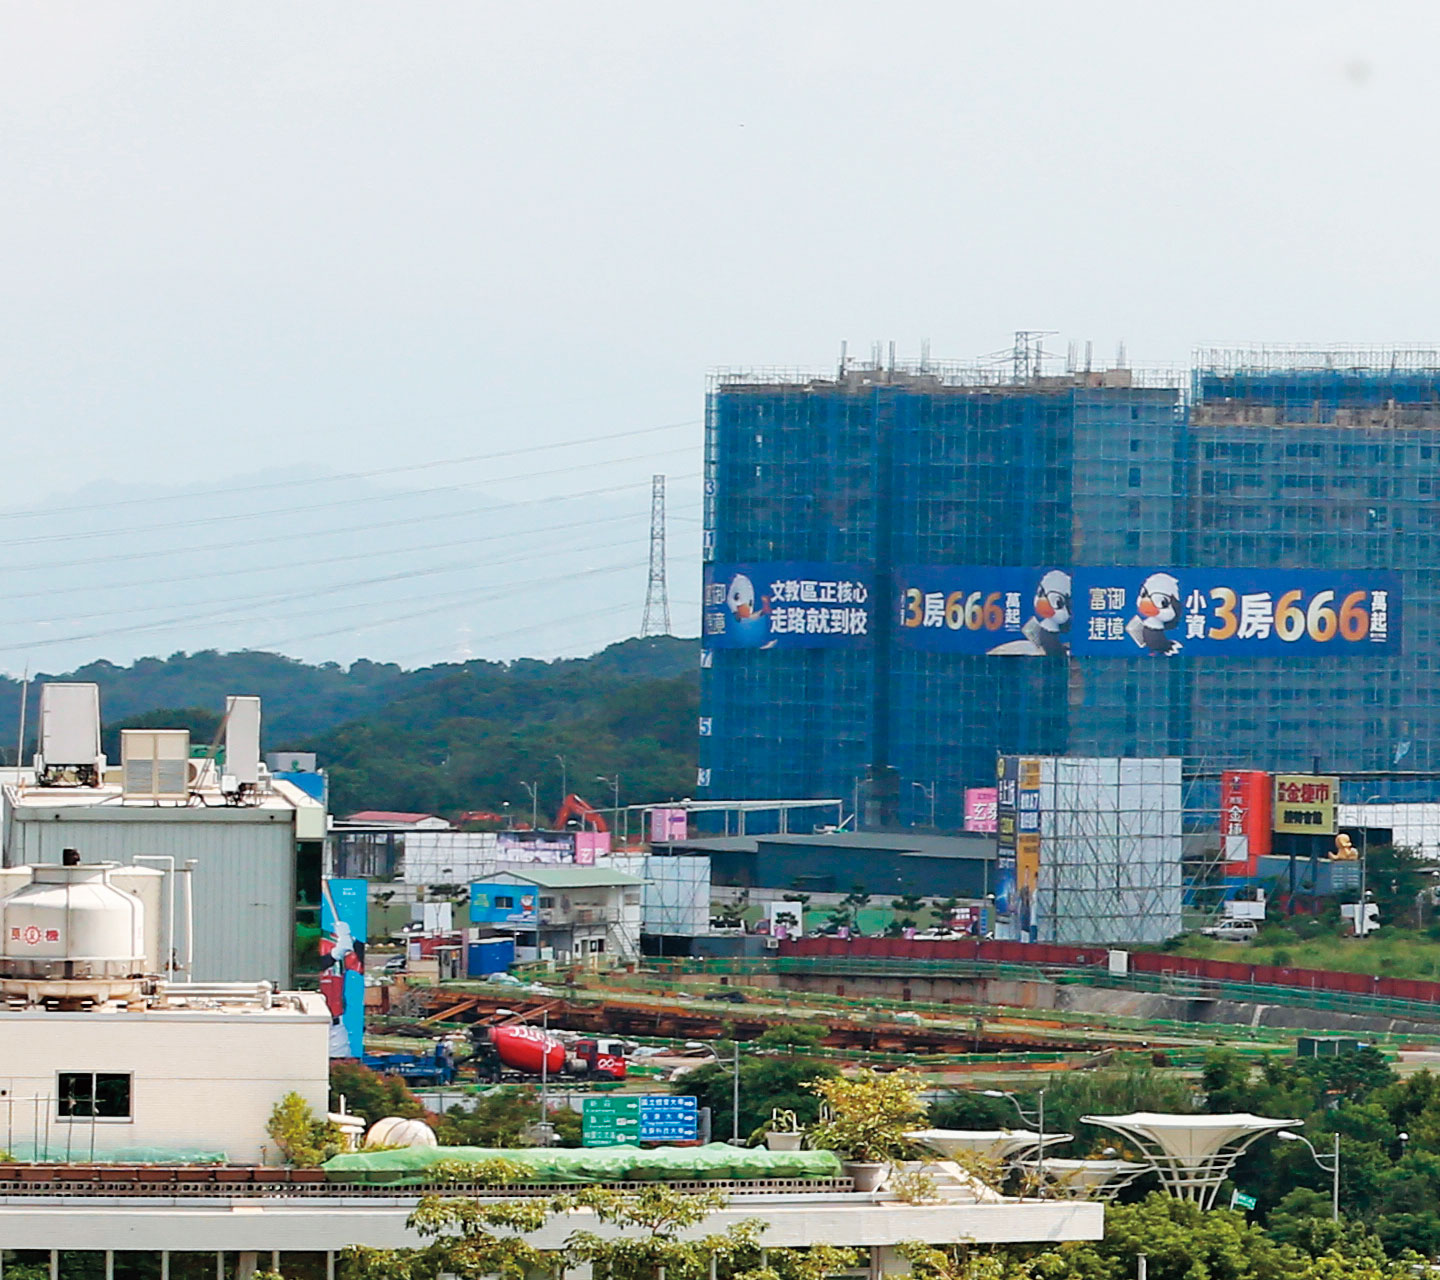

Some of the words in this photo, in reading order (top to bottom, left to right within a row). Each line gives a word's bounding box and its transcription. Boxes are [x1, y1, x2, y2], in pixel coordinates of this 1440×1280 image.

[769, 607, 868, 636] 走路就到校
[1184, 589, 1208, 639] 小資
[1208, 586, 1370, 642] 3房666
[1370, 590, 1389, 632] 萬起
